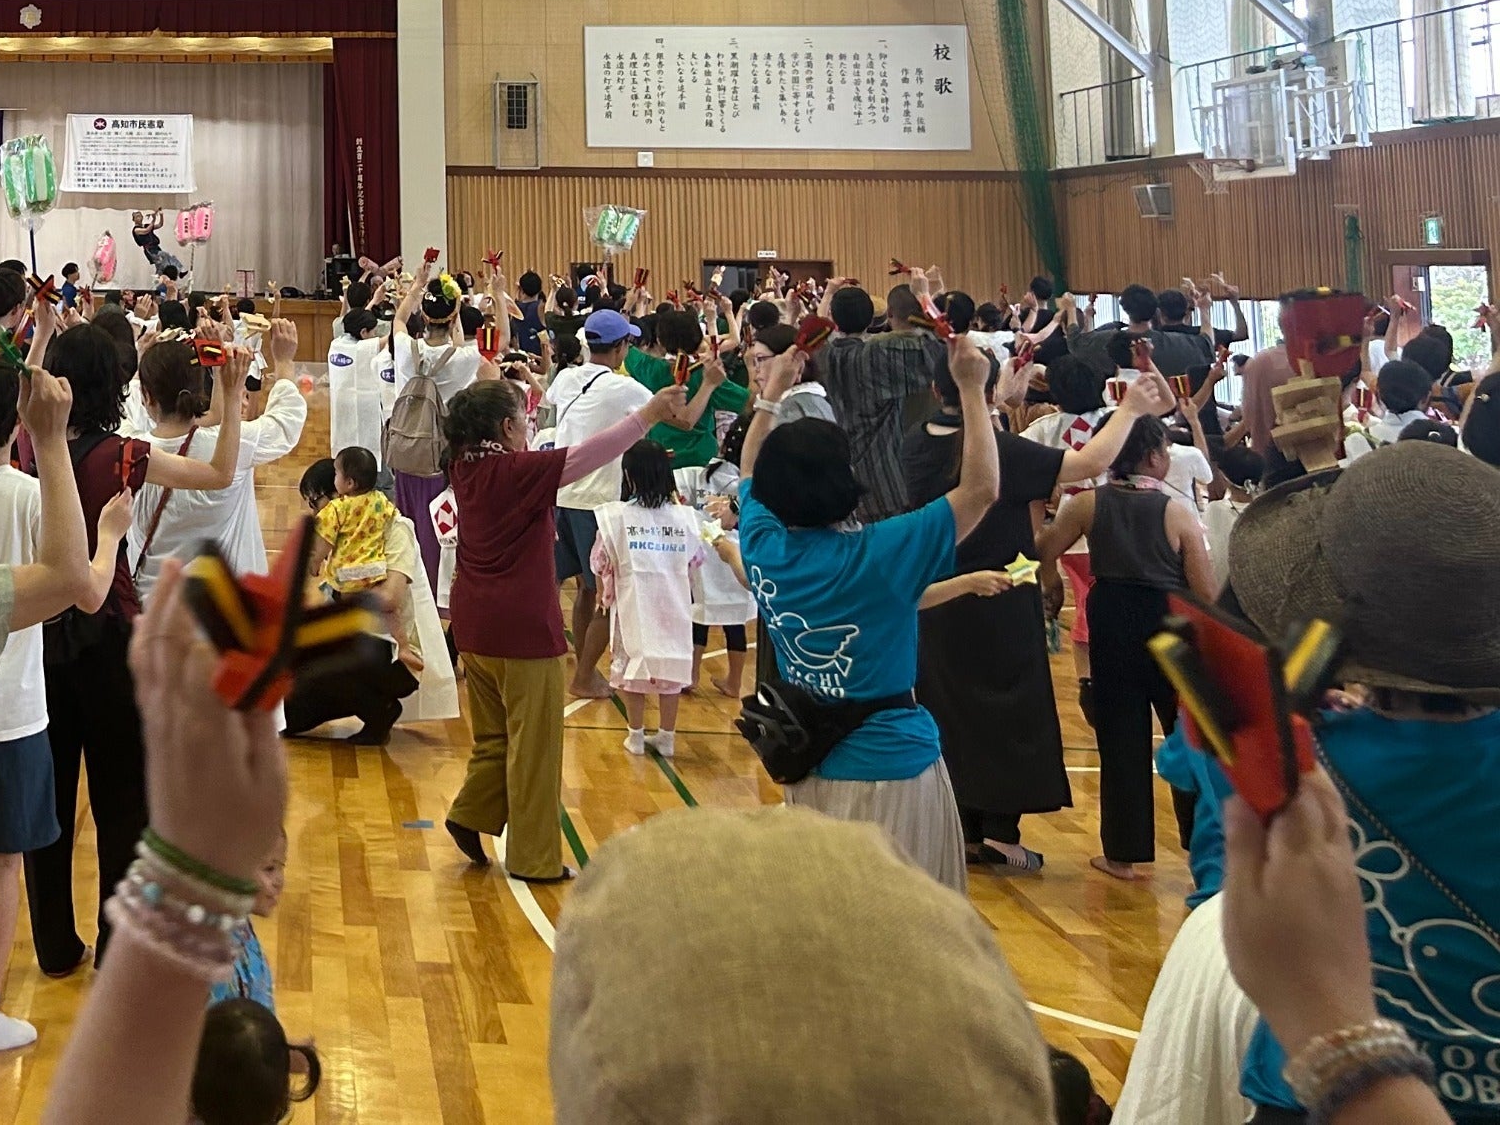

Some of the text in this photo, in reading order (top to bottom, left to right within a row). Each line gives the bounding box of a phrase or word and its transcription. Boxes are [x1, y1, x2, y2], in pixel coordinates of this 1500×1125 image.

[933, 44, 953, 95] 校歌
[111, 119, 165, 129] 高知市民憲章
[626, 525, 685, 537] 高知新聞社
